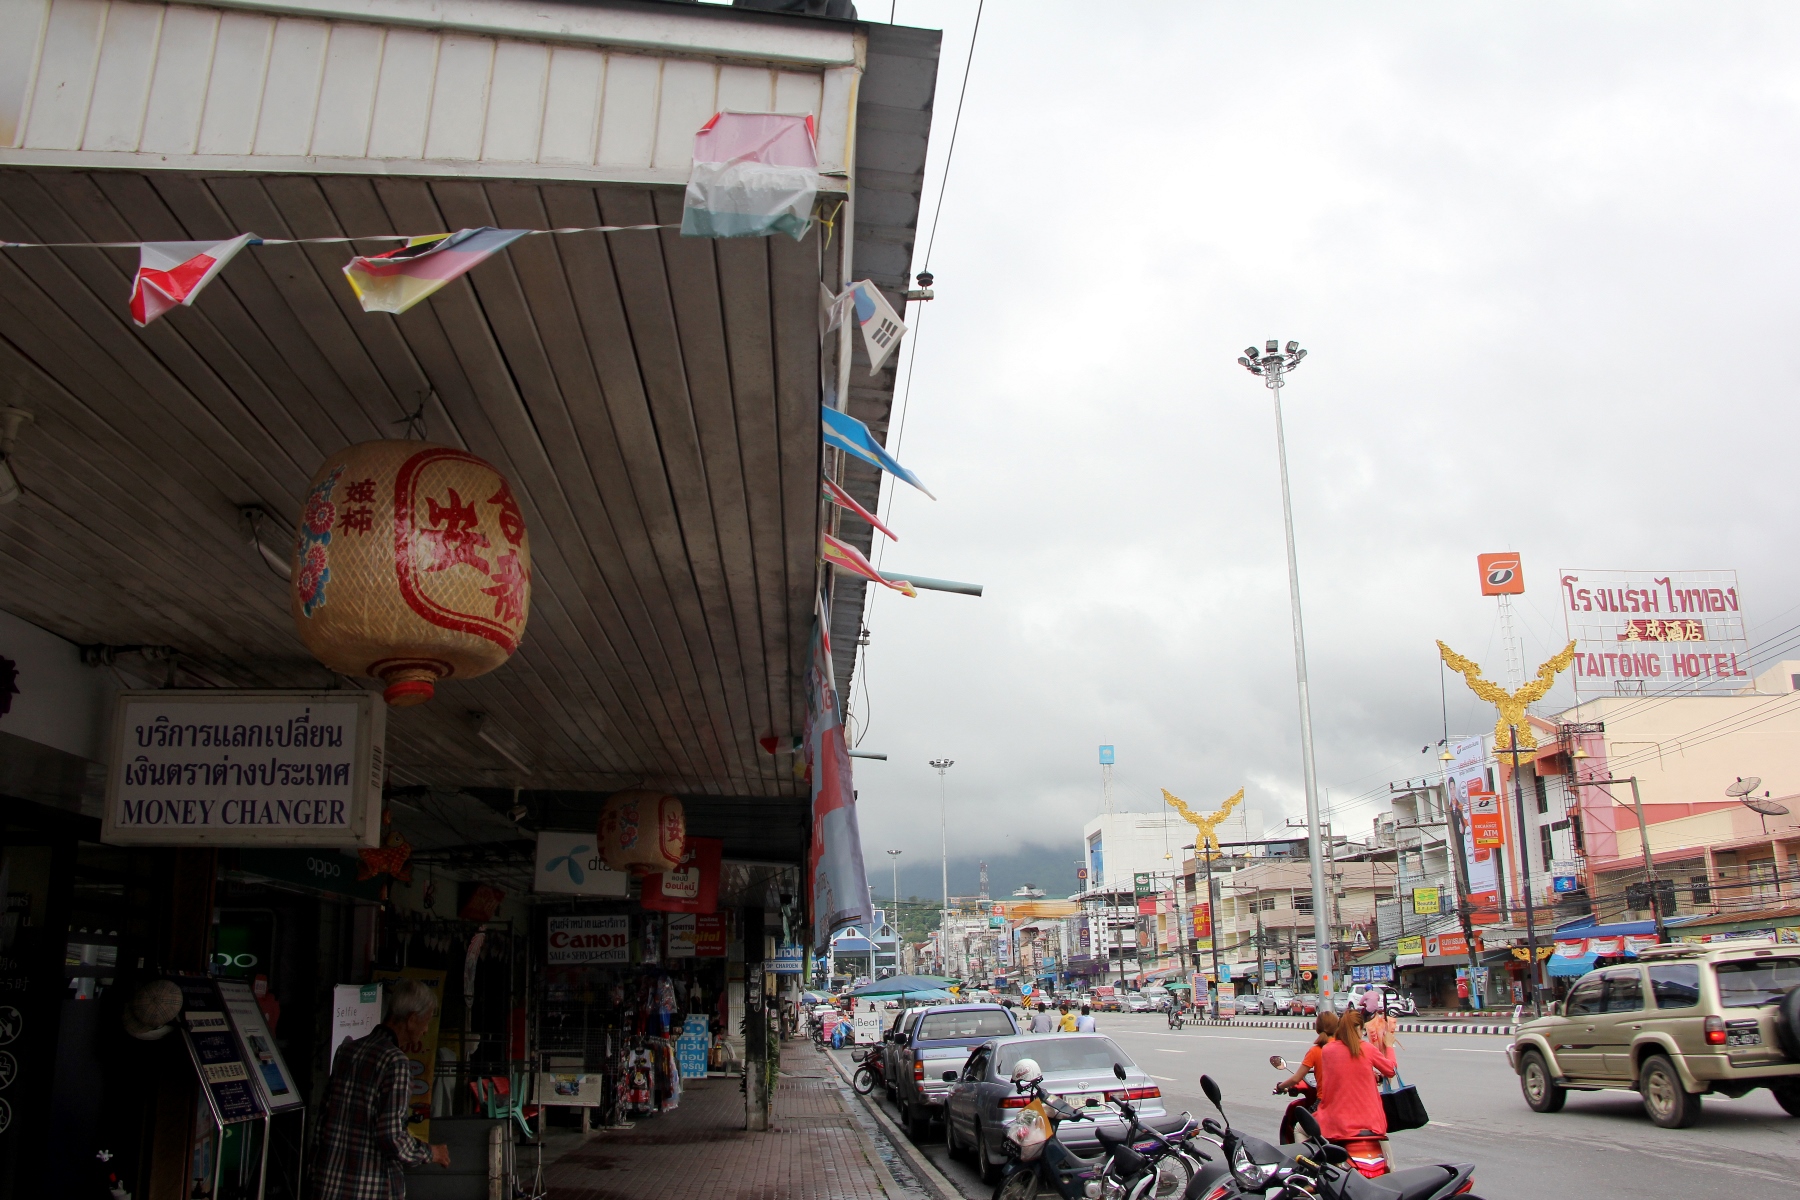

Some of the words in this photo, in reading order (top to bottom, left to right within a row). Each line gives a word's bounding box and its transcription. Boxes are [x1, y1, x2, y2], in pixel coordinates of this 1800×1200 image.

[1561, 575, 1659, 613] โรงแรม
[1654, 576, 1739, 613] ไททอง
[1573, 652, 1661, 678] TAITONG
[1672, 652, 1747, 678] HOTEL
[135, 707, 344, 748] บริการแลกเปลี่ยน
[124, 754, 351, 786] เงินตราต่างประเทศ
[121, 799, 216, 825] MONEY
[221, 799, 346, 825] CHANGER
[306, 856, 341, 879] oppo
[665, 881, 696, 890] ออนไลน์
[550, 931, 626, 948] Canon
[549, 951, 566, 960] SALE
[571, 951, 600, 960] SERVICE
[600, 950, 626, 960] CENTER
[336, 1006, 357, 1018] Selfie
[855, 1017, 878, 1027] iBeat
[680, 1041, 705, 1051] แว่น
[680, 1050, 705, 1061] ท็อป
[682, 1060, 704, 1072] จริญ
